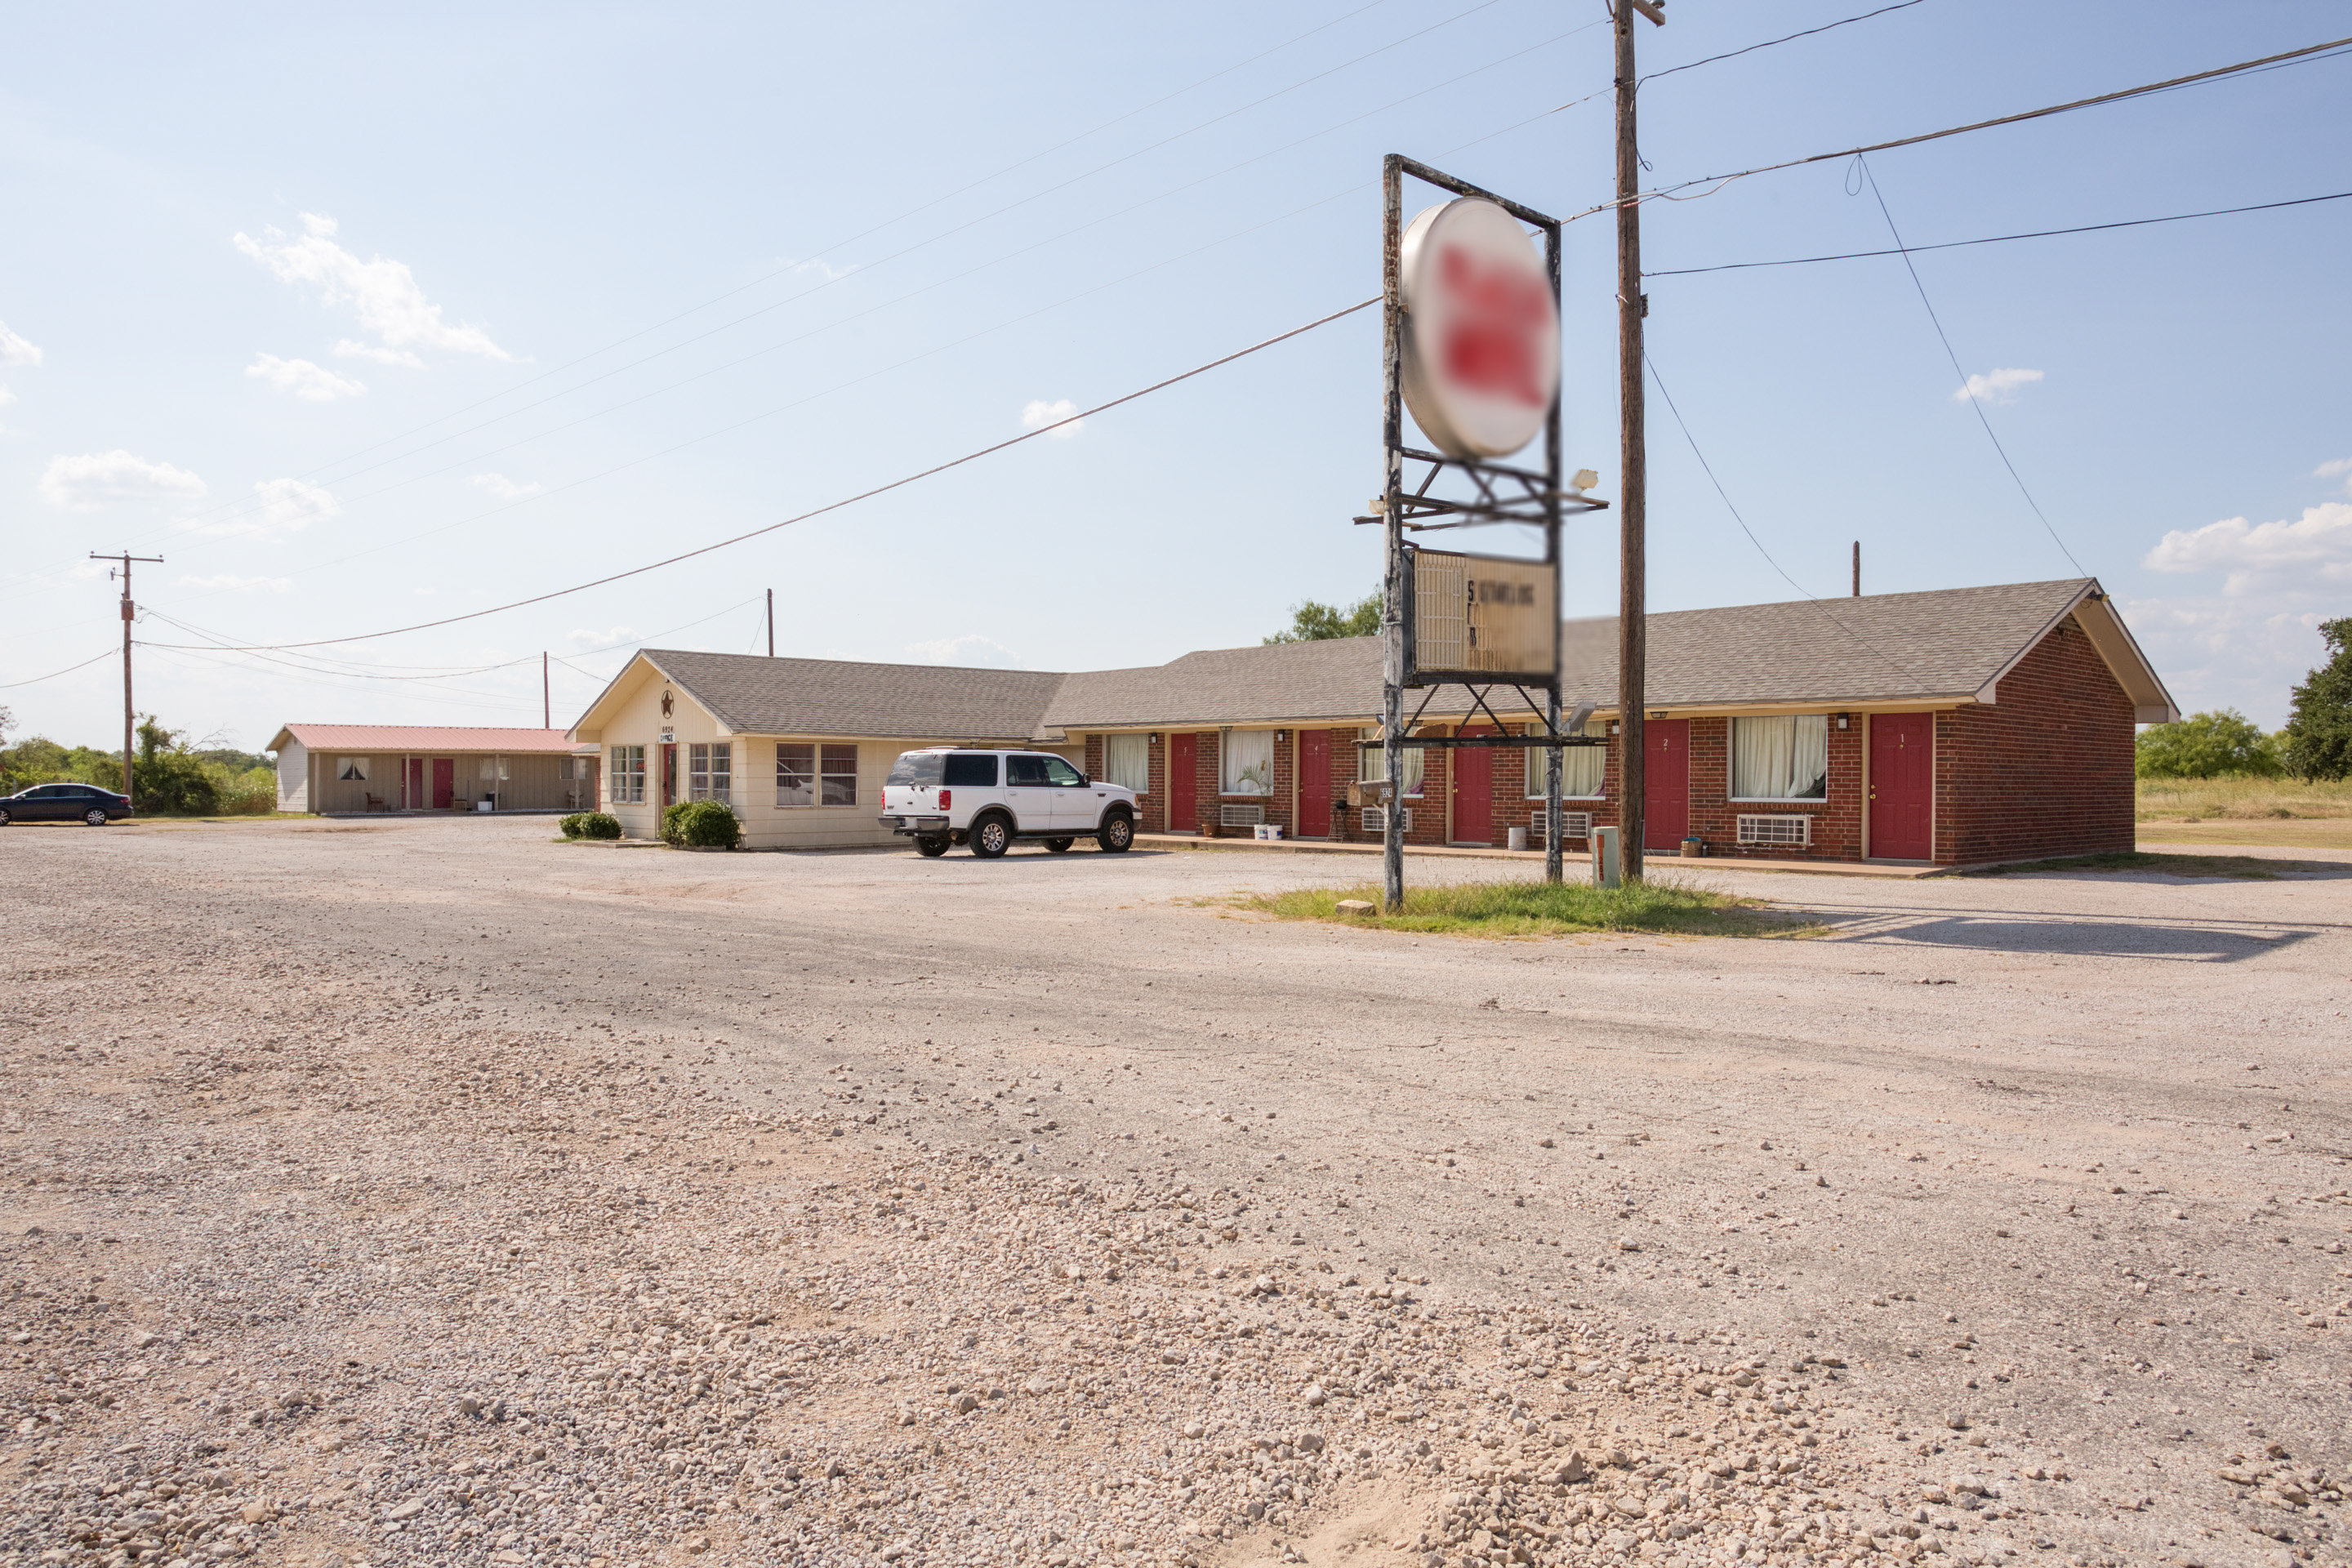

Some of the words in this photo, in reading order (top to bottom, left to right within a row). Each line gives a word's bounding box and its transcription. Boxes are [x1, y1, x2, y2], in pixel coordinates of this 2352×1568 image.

[660, 734, 674, 742] OFFICE
[1663, 738, 1668, 746] 2
[1380, 788, 1392, 797] 6924
